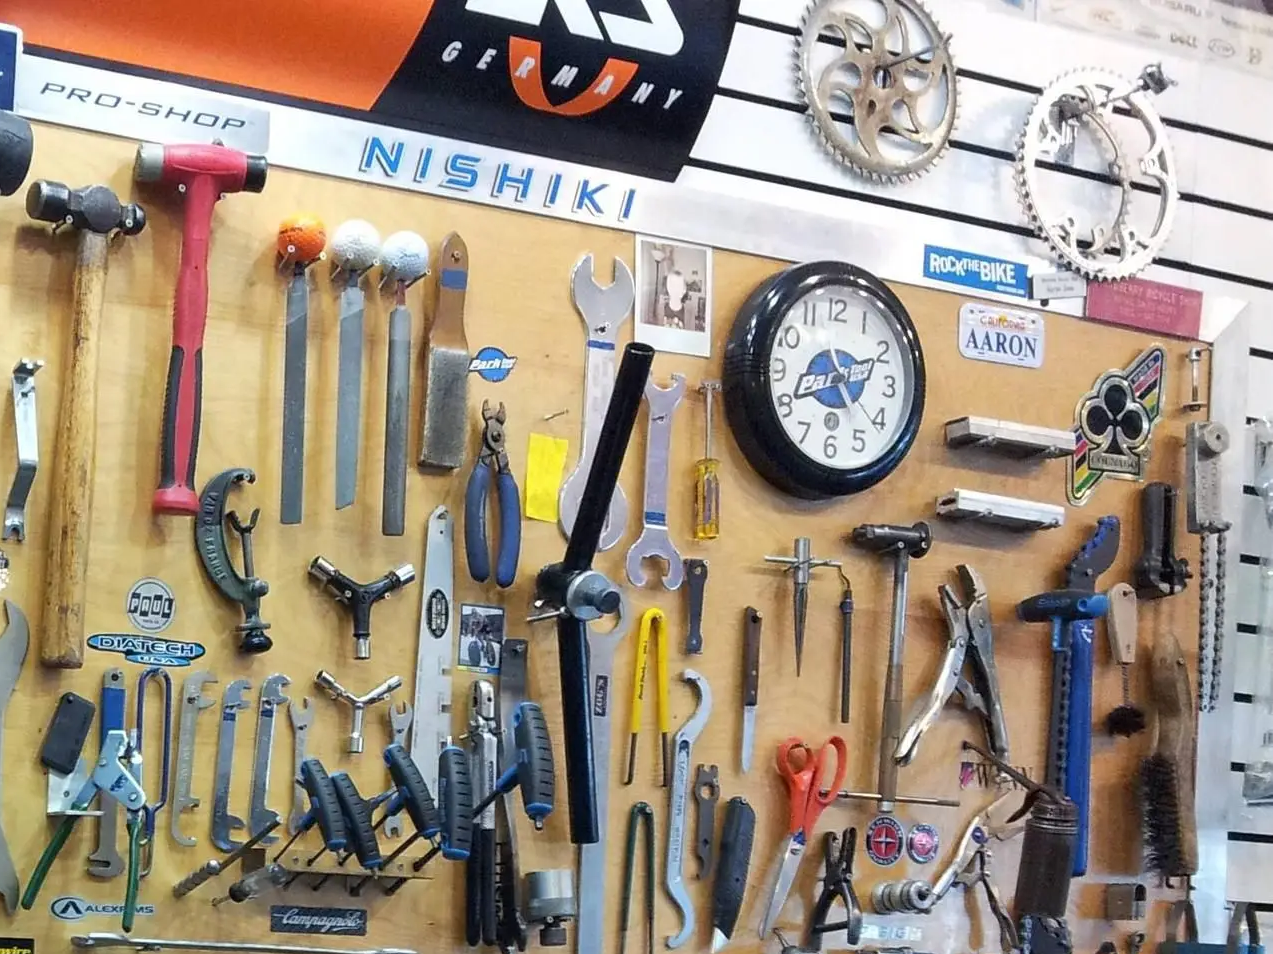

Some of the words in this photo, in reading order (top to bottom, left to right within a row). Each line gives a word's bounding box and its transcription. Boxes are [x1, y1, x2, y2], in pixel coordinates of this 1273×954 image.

[441, 41, 682, 110] GERMANY
[40, 82, 246, 130] PRO-SHOP
[358, 136, 636, 222] NISHIKI
[804, 301, 816, 326] 11
[828, 298, 847, 323] 12
[861, 311, 866, 334] 1
[876, 340, 890, 364] 2
[965, 328, 1038, 358] AARON
[774, 358, 786, 382] 9
[882, 376, 896, 398] 3
[777, 393, 793, 418] 8
[872, 407, 886, 431] 4
[797, 421, 811, 444] 7
[852, 429, 866, 453] 5
[823, 435, 837, 459] 6
[128, 593, 174, 618] PAUL
[98, 636, 195, 657] DIATECH
[273, 908, 364, 932] Campagnolo
